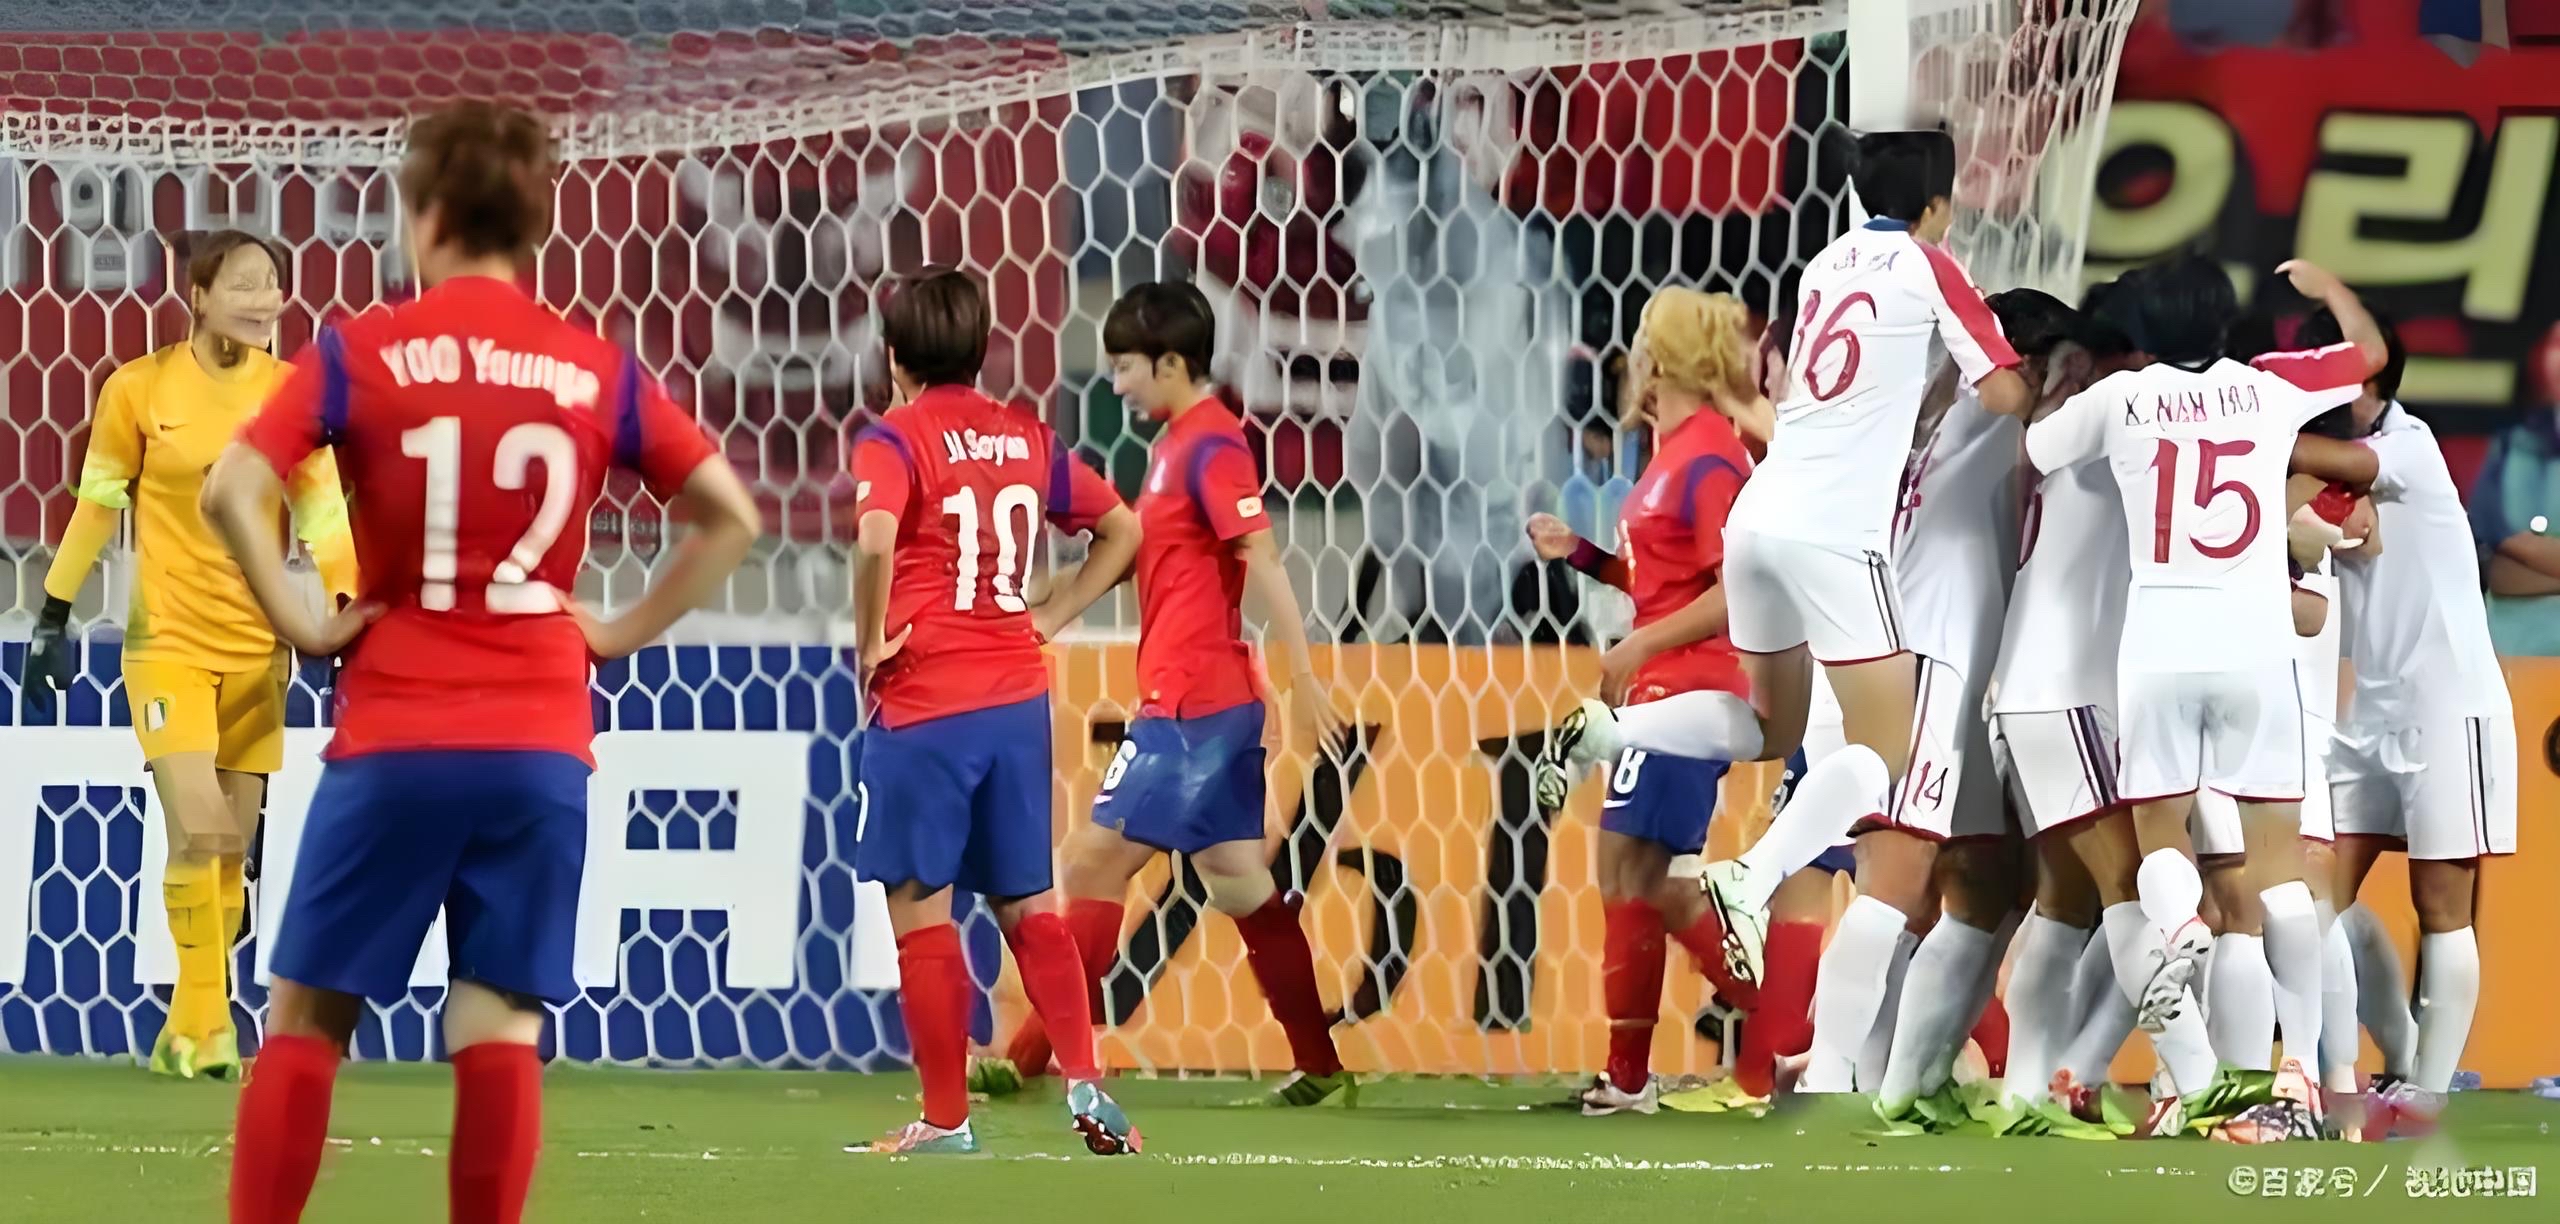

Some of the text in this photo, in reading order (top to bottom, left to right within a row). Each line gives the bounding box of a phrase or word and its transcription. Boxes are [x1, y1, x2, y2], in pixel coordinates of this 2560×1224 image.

[379, 334, 462, 388] YOO
[401, 415, 578, 615] 12
[942, 483, 1039, 613] 10
[2145, 438, 2261, 564] 15
[1911, 760, 1949, 812] 14
